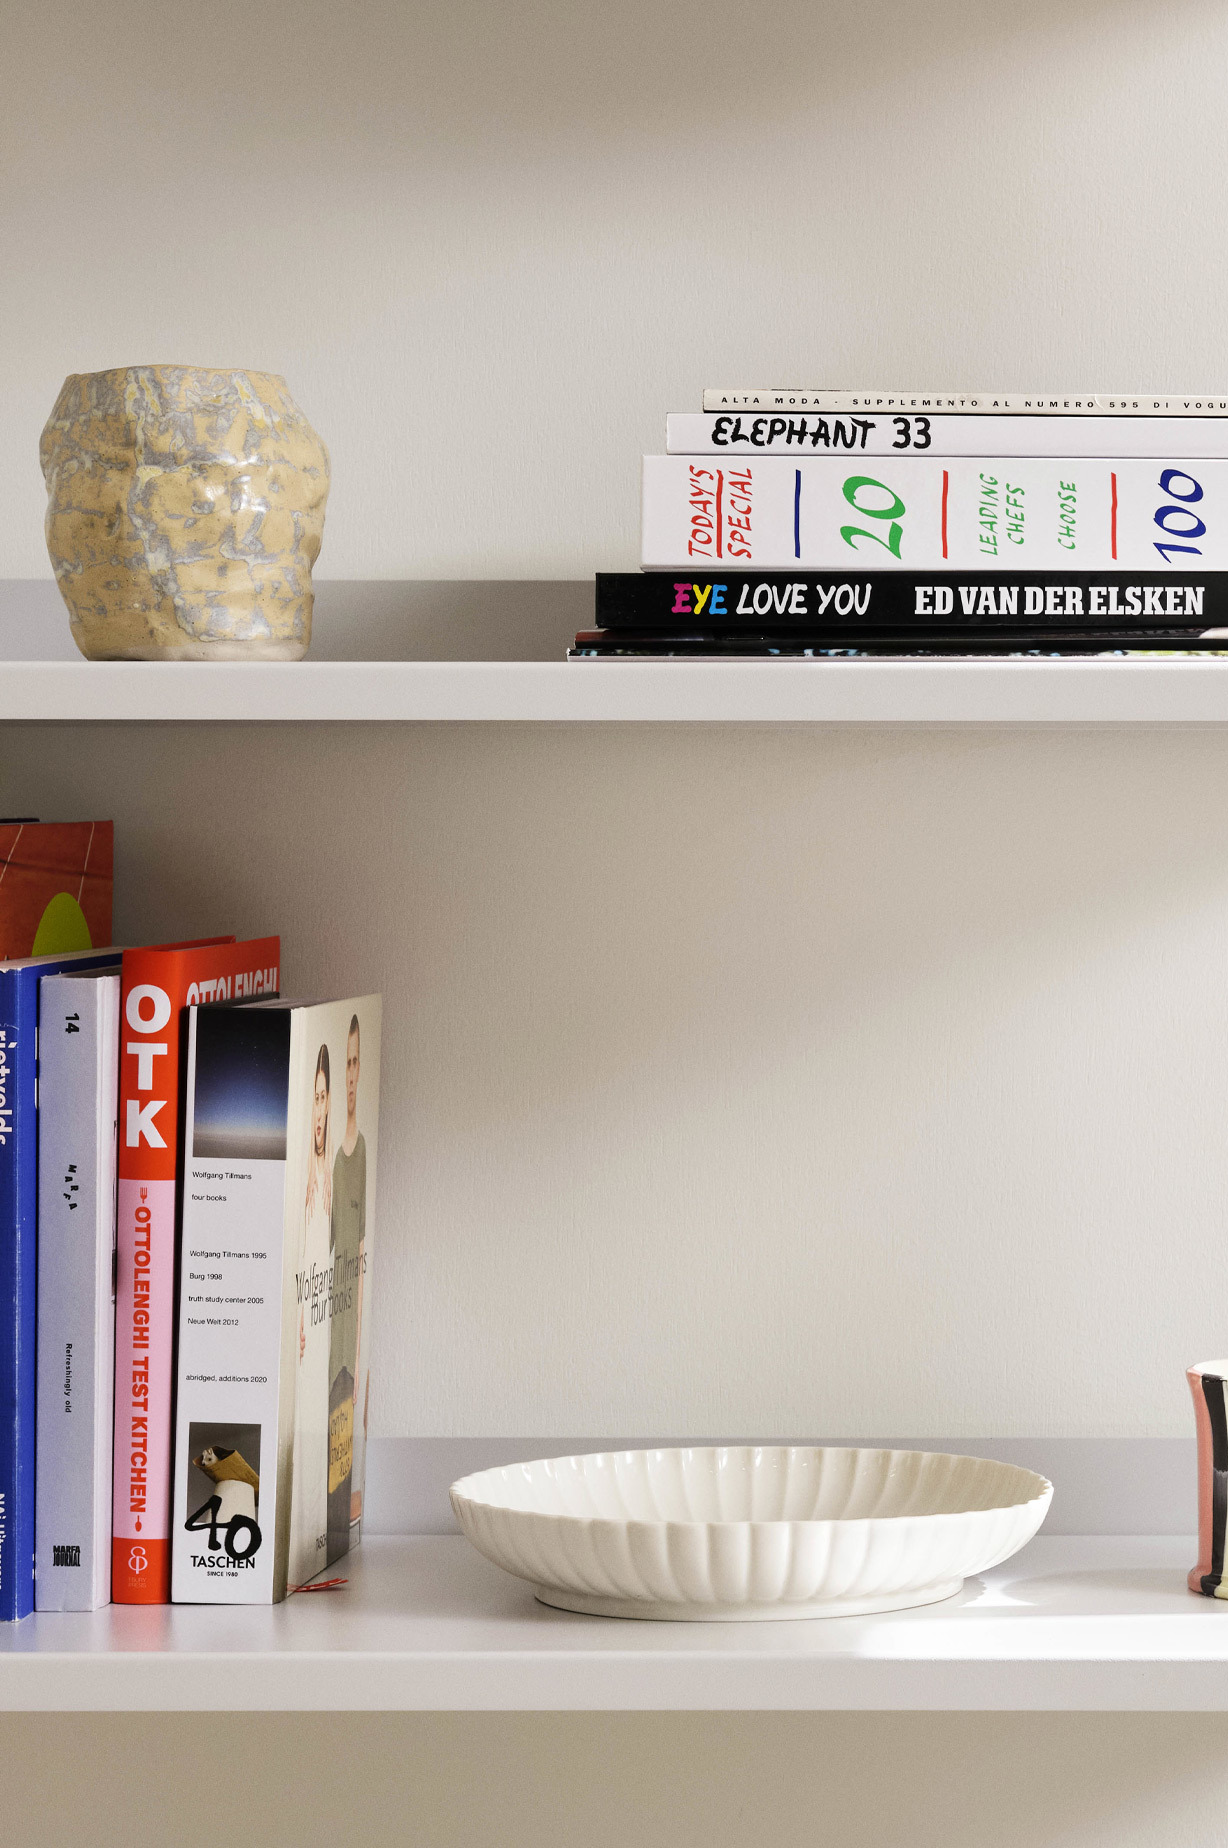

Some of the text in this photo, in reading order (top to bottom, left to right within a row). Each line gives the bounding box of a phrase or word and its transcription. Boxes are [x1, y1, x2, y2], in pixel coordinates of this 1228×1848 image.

[721, 396, 760, 404] ALTA
[774, 397, 820, 405] MODA
[852, 398, 978, 407] SUPPLEMENTO
[1024, 400, 1094, 408] NUMERO
[1109, 401, 1139, 409] 595
[1153, 401, 1169, 409] DI
[712, 416, 932, 449] ELEPHANT 33
[687, 464, 753, 559] TODAY'S SPECIAL
[839, 475, 906, 560] 20
[978, 472, 1025, 556] LEADING CHEFS
[1057, 480, 1077, 550] CHOOSE
[1152, 468, 1207, 564] 100
[671, 582, 873, 616] EYE LOVE YOU
[914, 586, 1205, 615] ED VAN DER ELSKEN
[64, 1012, 80, 1034] 14
[125, 984, 172, 1149] OTK
[62, 1164, 79, 1211] MARFA
[192, 1171, 252, 1181] Wolfgang Tillmans
[191, 1193, 227, 1202] four books
[190, 1250, 267, 1260] Wolfgang Tillmans 1995
[189, 1272, 223, 1282] Burg 1998
[295, 1249, 367, 1305] Wolfgang Tillmans
[205, 1296, 224, 1304] study
[246, 1296, 264, 1305] 2005
[187, 1317, 206, 1325] Neue
[222, 1318, 239, 1326] 2012
[129, 1206, 151, 1513] OTTOLENGHI TEST KITCHEN
[63, 1343, 73, 1413] Refreshingly old
[185, 1374, 268, 1384] abridged, additions 2020
[184, 1494, 262, 1560] 40
[53, 1545, 81, 1553] MARFA
[53, 1552, 81, 1567] JOURNAL
[190, 1555, 256, 1569] TASCHEN
